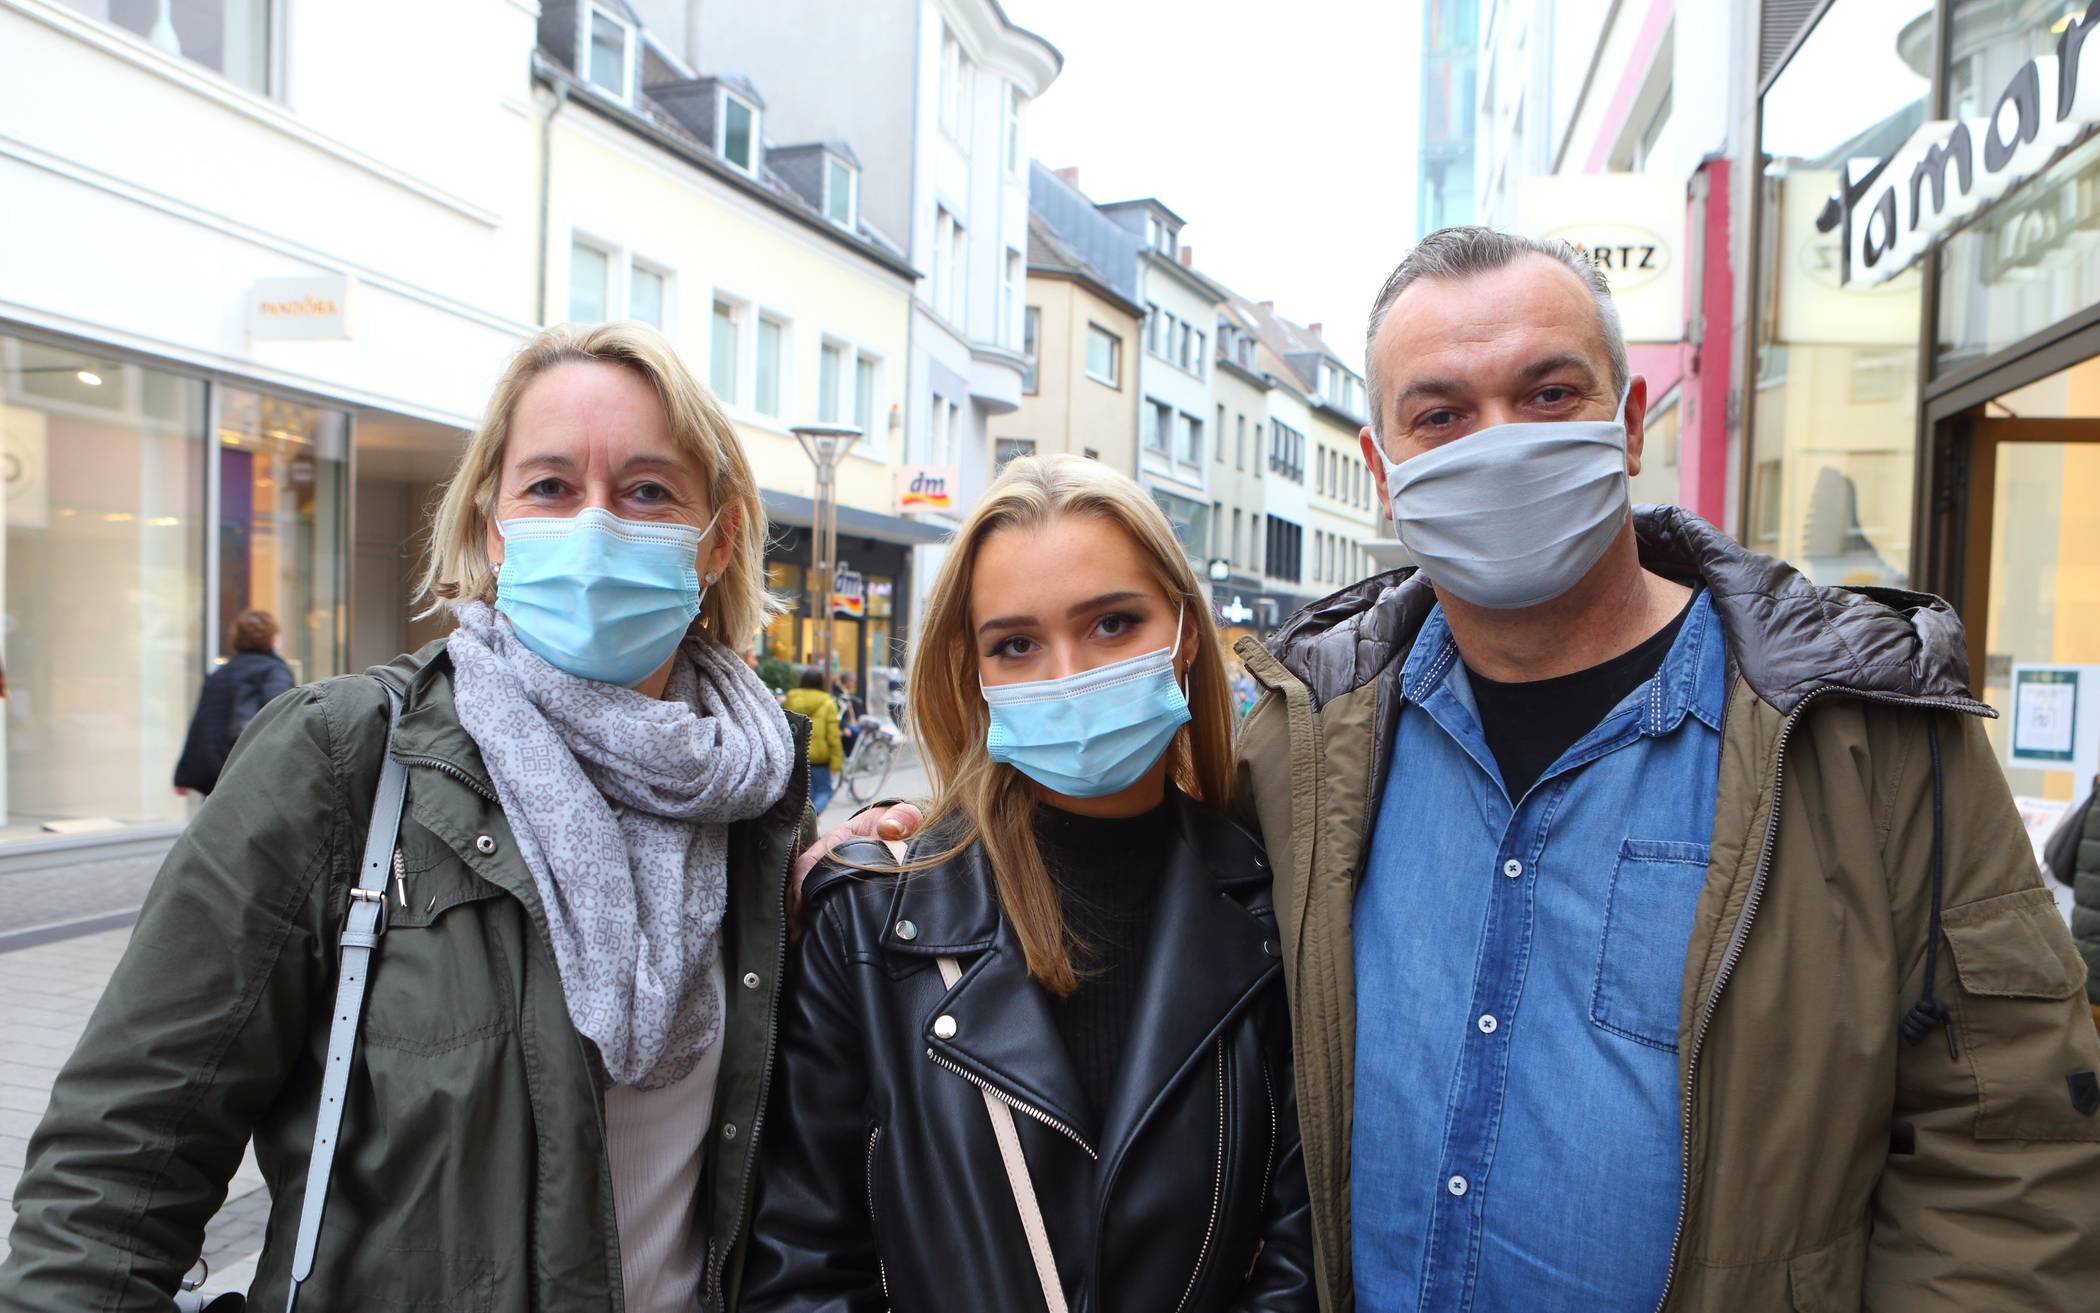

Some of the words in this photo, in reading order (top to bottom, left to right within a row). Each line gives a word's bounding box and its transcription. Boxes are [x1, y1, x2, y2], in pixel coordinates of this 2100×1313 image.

[1576, 243, 1656, 270] RTZ
[910, 471, 945, 496] dm
[834, 565, 860, 595] dm
